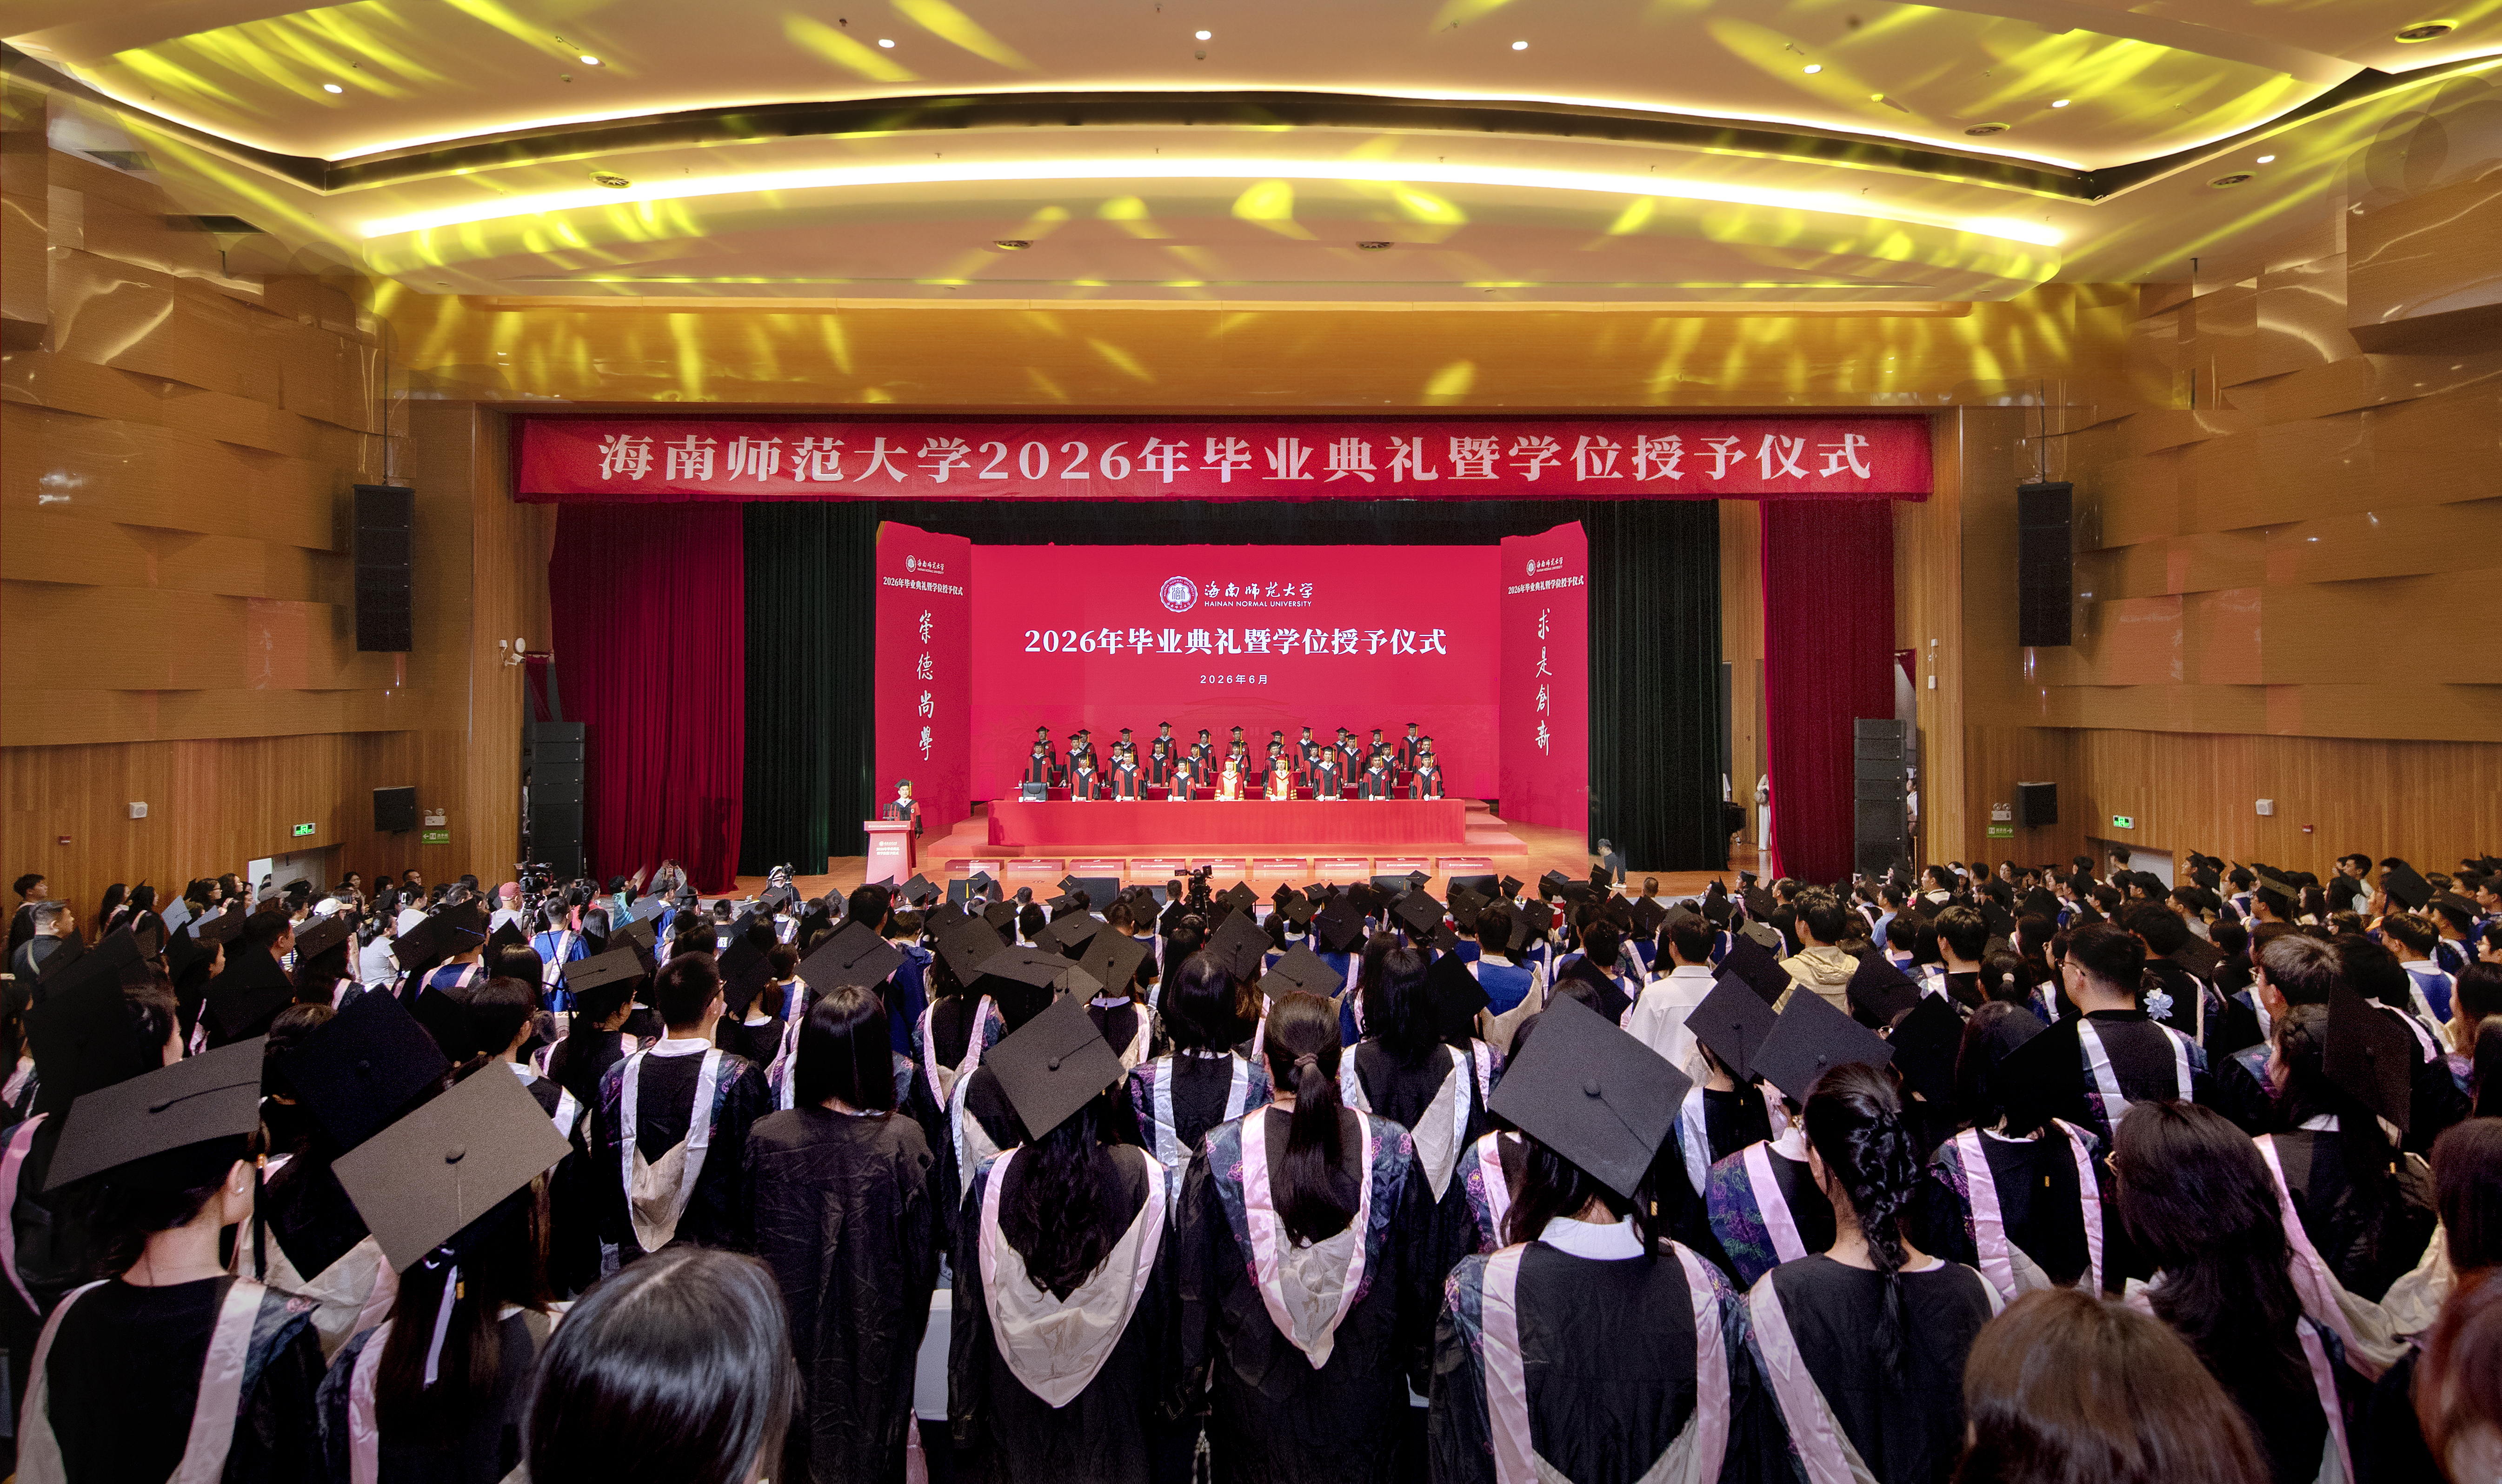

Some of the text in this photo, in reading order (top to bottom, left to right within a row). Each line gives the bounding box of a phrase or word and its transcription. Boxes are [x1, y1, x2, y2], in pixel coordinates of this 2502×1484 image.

[598, 433, 1870, 484] 海南师范大学2026年毕业典礼暨学位授予仪式
[883, 576, 963, 596] 2026年毕业典礼暨学位授予仪式
[1204, 580, 1313, 600] 海南师范大学
[1508, 575, 1584, 594] 2026年毕业典礼暨学位授予仪式
[1025, 627, 1446, 655] 2026年毕业典礼暨学位授予仪式
[1200, 674, 1267, 685] 2026年6月
